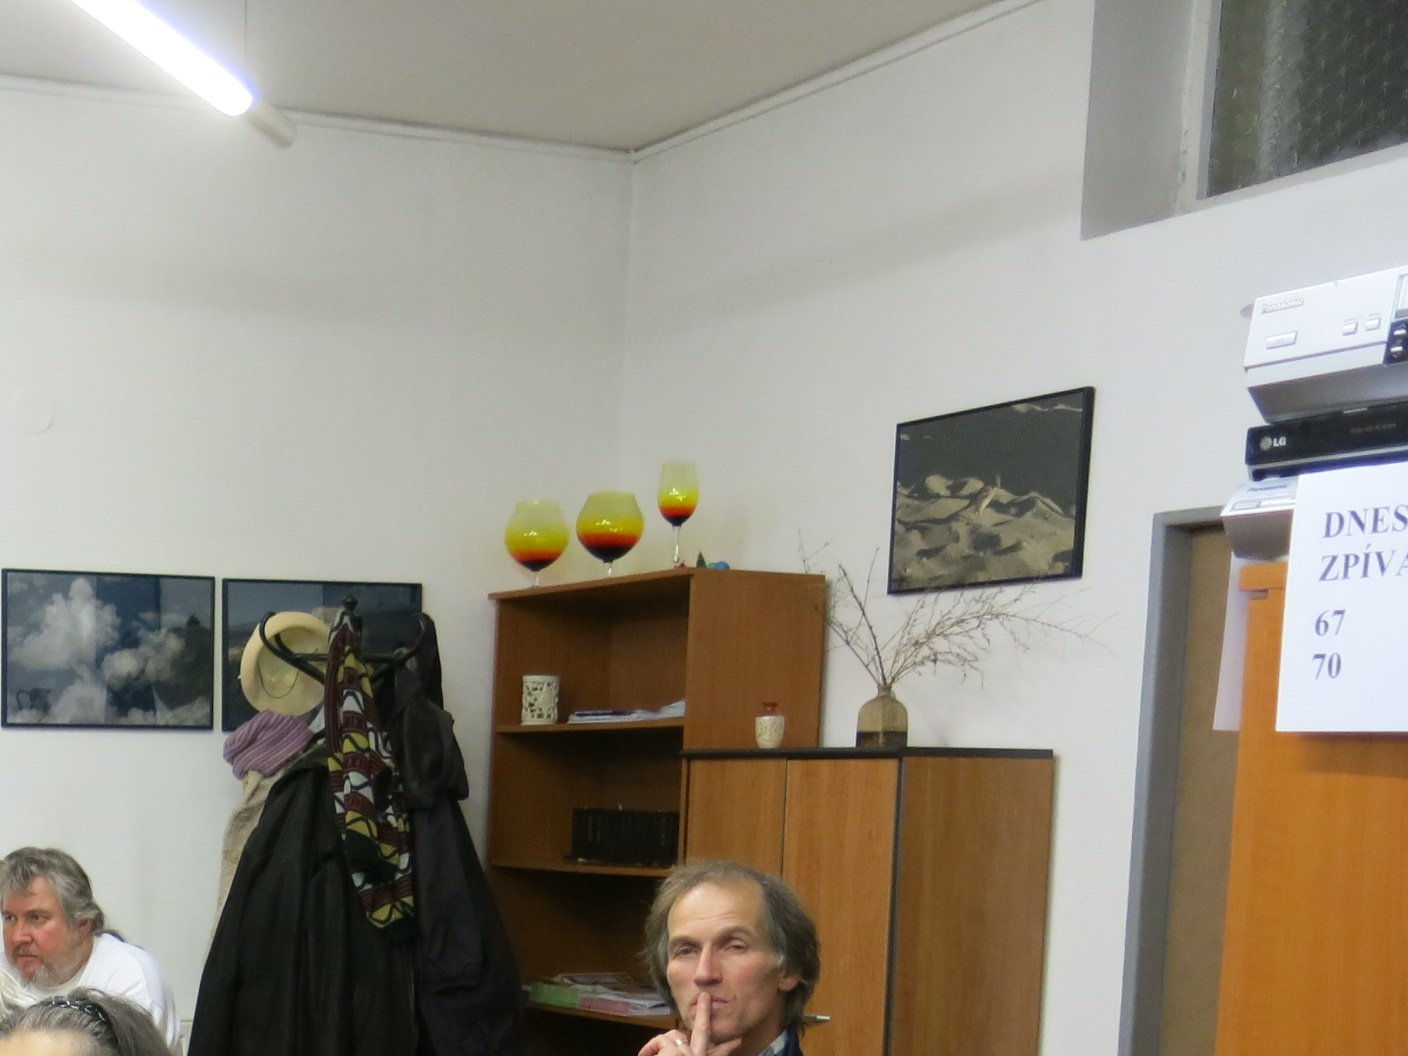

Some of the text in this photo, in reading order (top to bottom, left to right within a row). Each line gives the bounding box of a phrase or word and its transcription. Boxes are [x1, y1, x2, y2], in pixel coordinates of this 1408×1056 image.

[1273, 436, 1287, 447] LG
[1322, 504, 1408, 538] DNES
[1314, 609, 1346, 636] 67
[1312, 652, 1342, 680] 70
